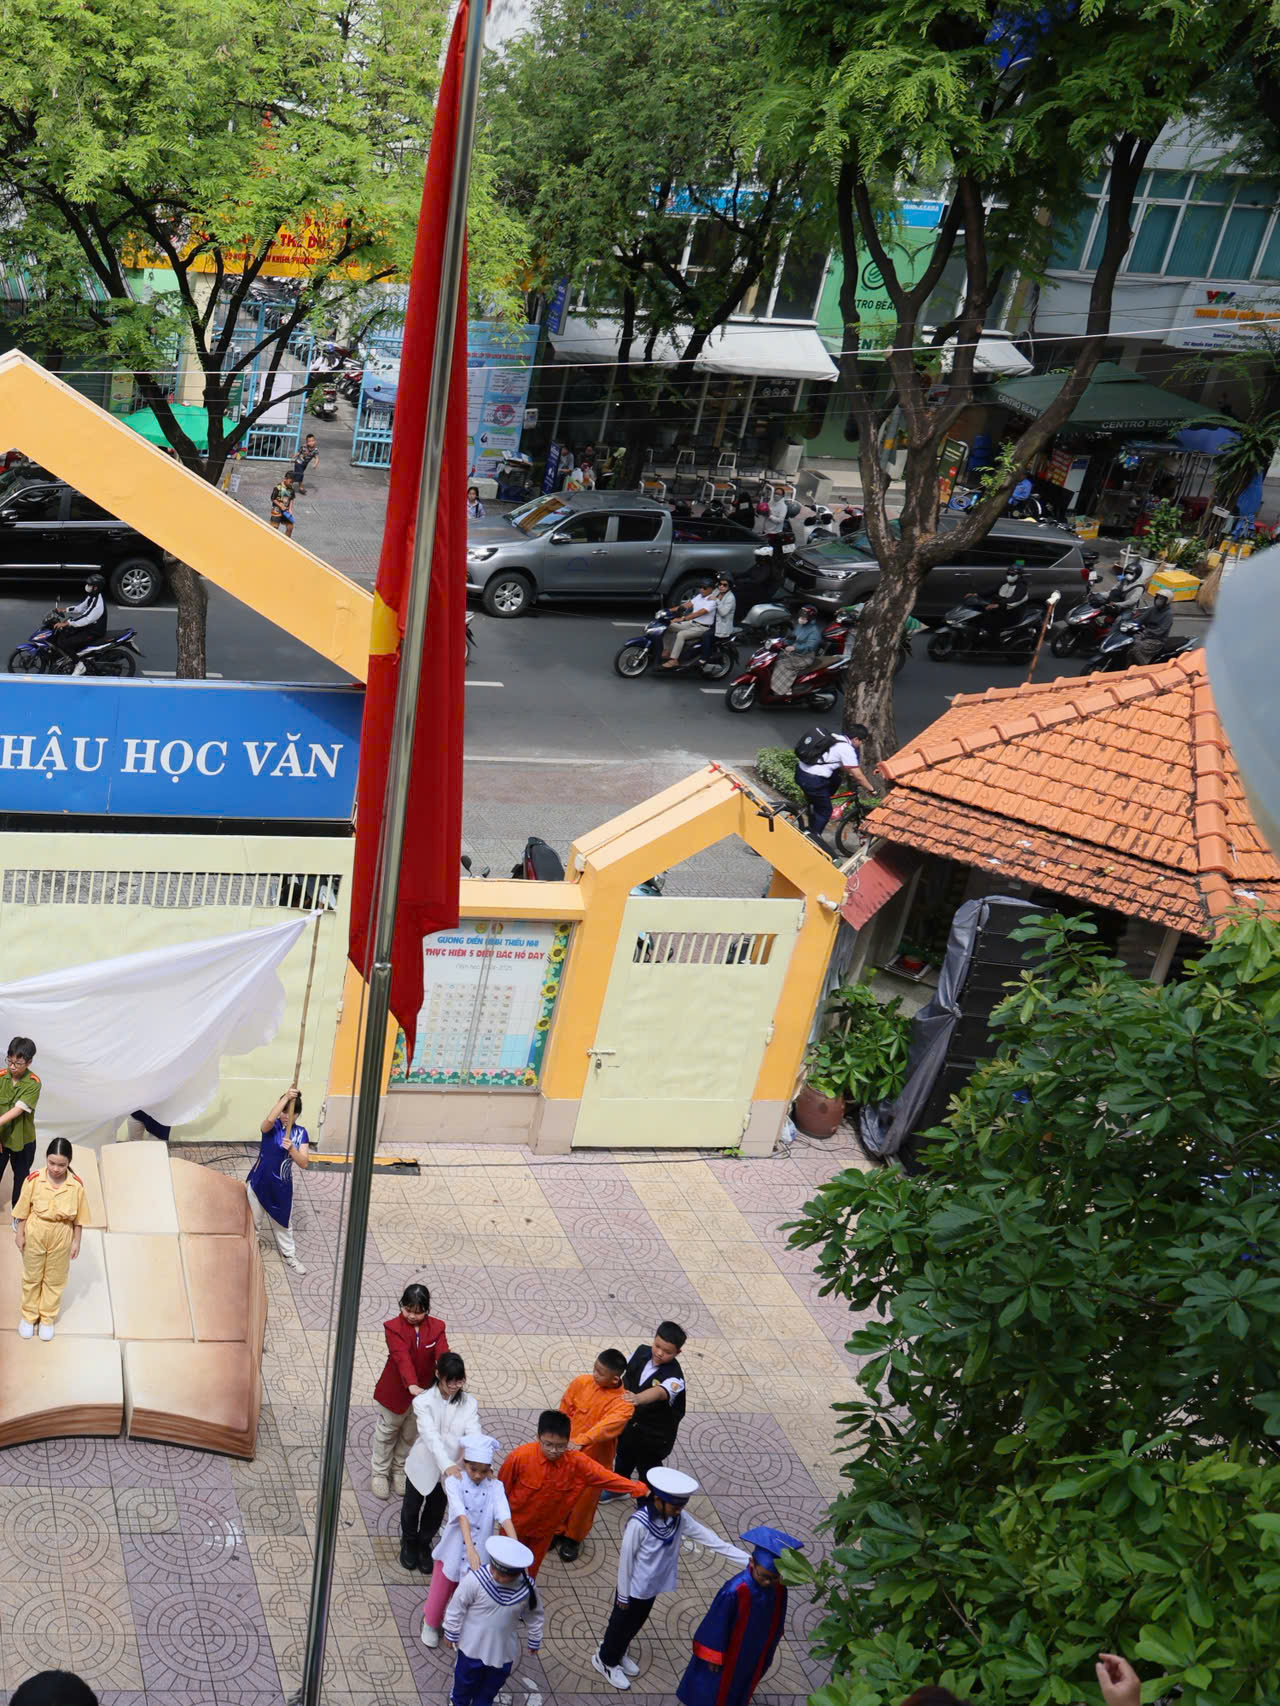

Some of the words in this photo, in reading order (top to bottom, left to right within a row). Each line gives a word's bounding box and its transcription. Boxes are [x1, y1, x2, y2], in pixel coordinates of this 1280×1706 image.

[998, 394, 1021, 410] CENTRO
[1021, 404, 1037, 417] BEAN
[1101, 420, 1145, 430] CENTRO
[120, 738, 228, 783] HỌC
[242, 732, 344, 778] VĂN
